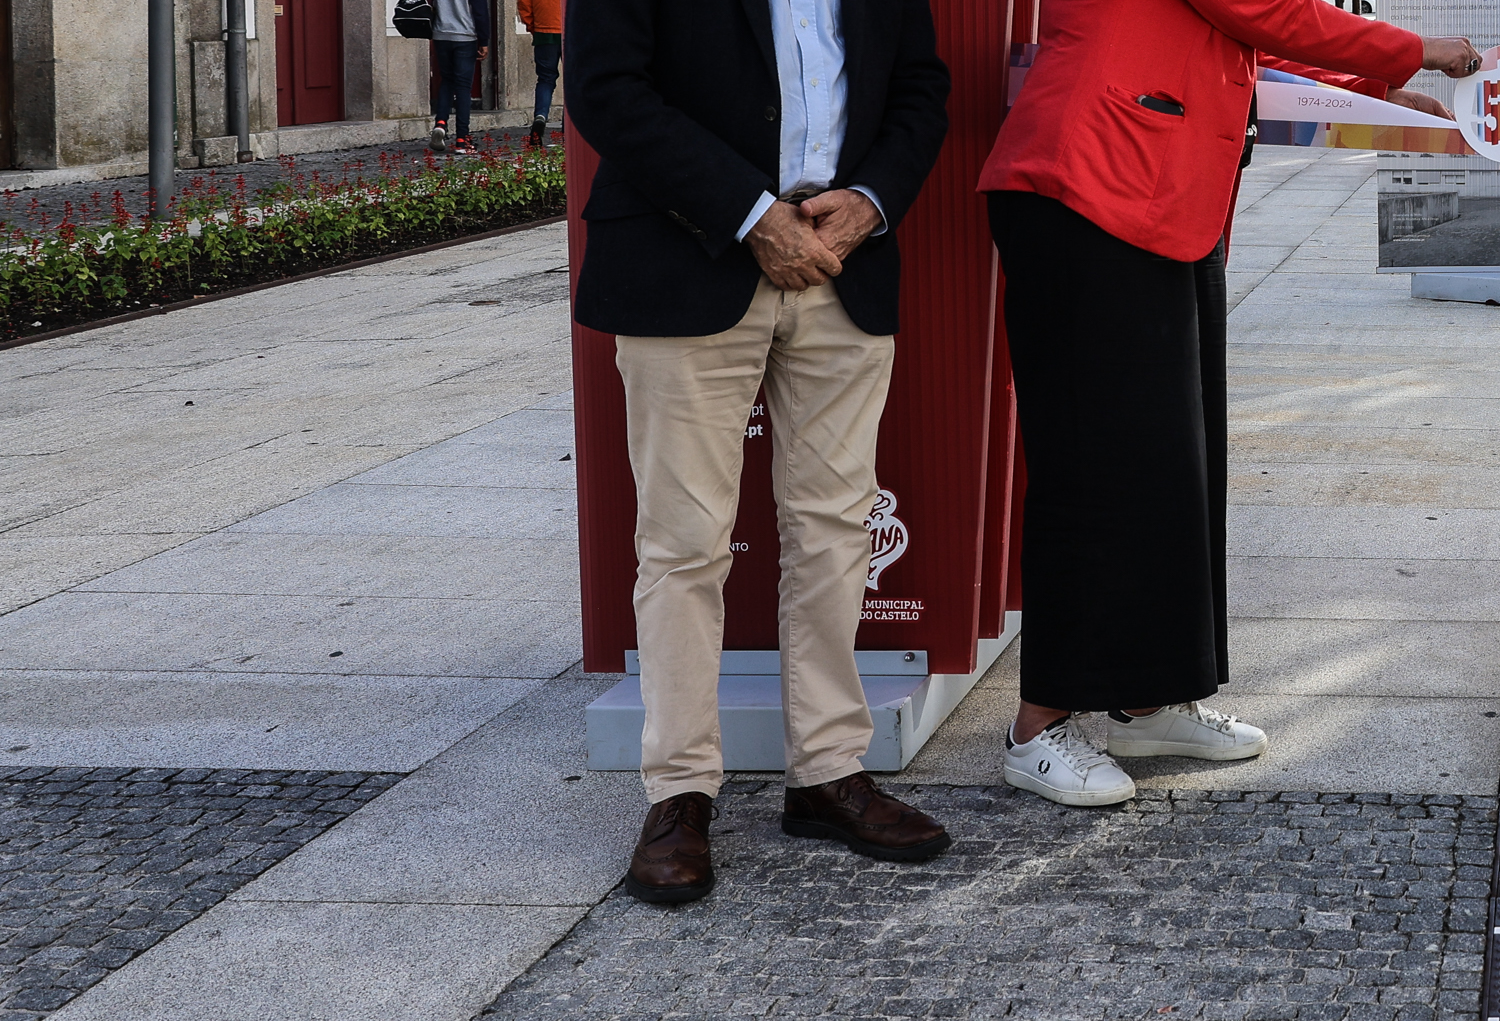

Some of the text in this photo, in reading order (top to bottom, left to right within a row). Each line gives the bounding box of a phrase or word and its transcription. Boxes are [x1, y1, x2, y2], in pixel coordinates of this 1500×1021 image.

[1297, 96, 1353, 108] 1974-2024
[865, 600, 924, 609] MUNICIPAL
[874, 611, 920, 620] CASTELO
